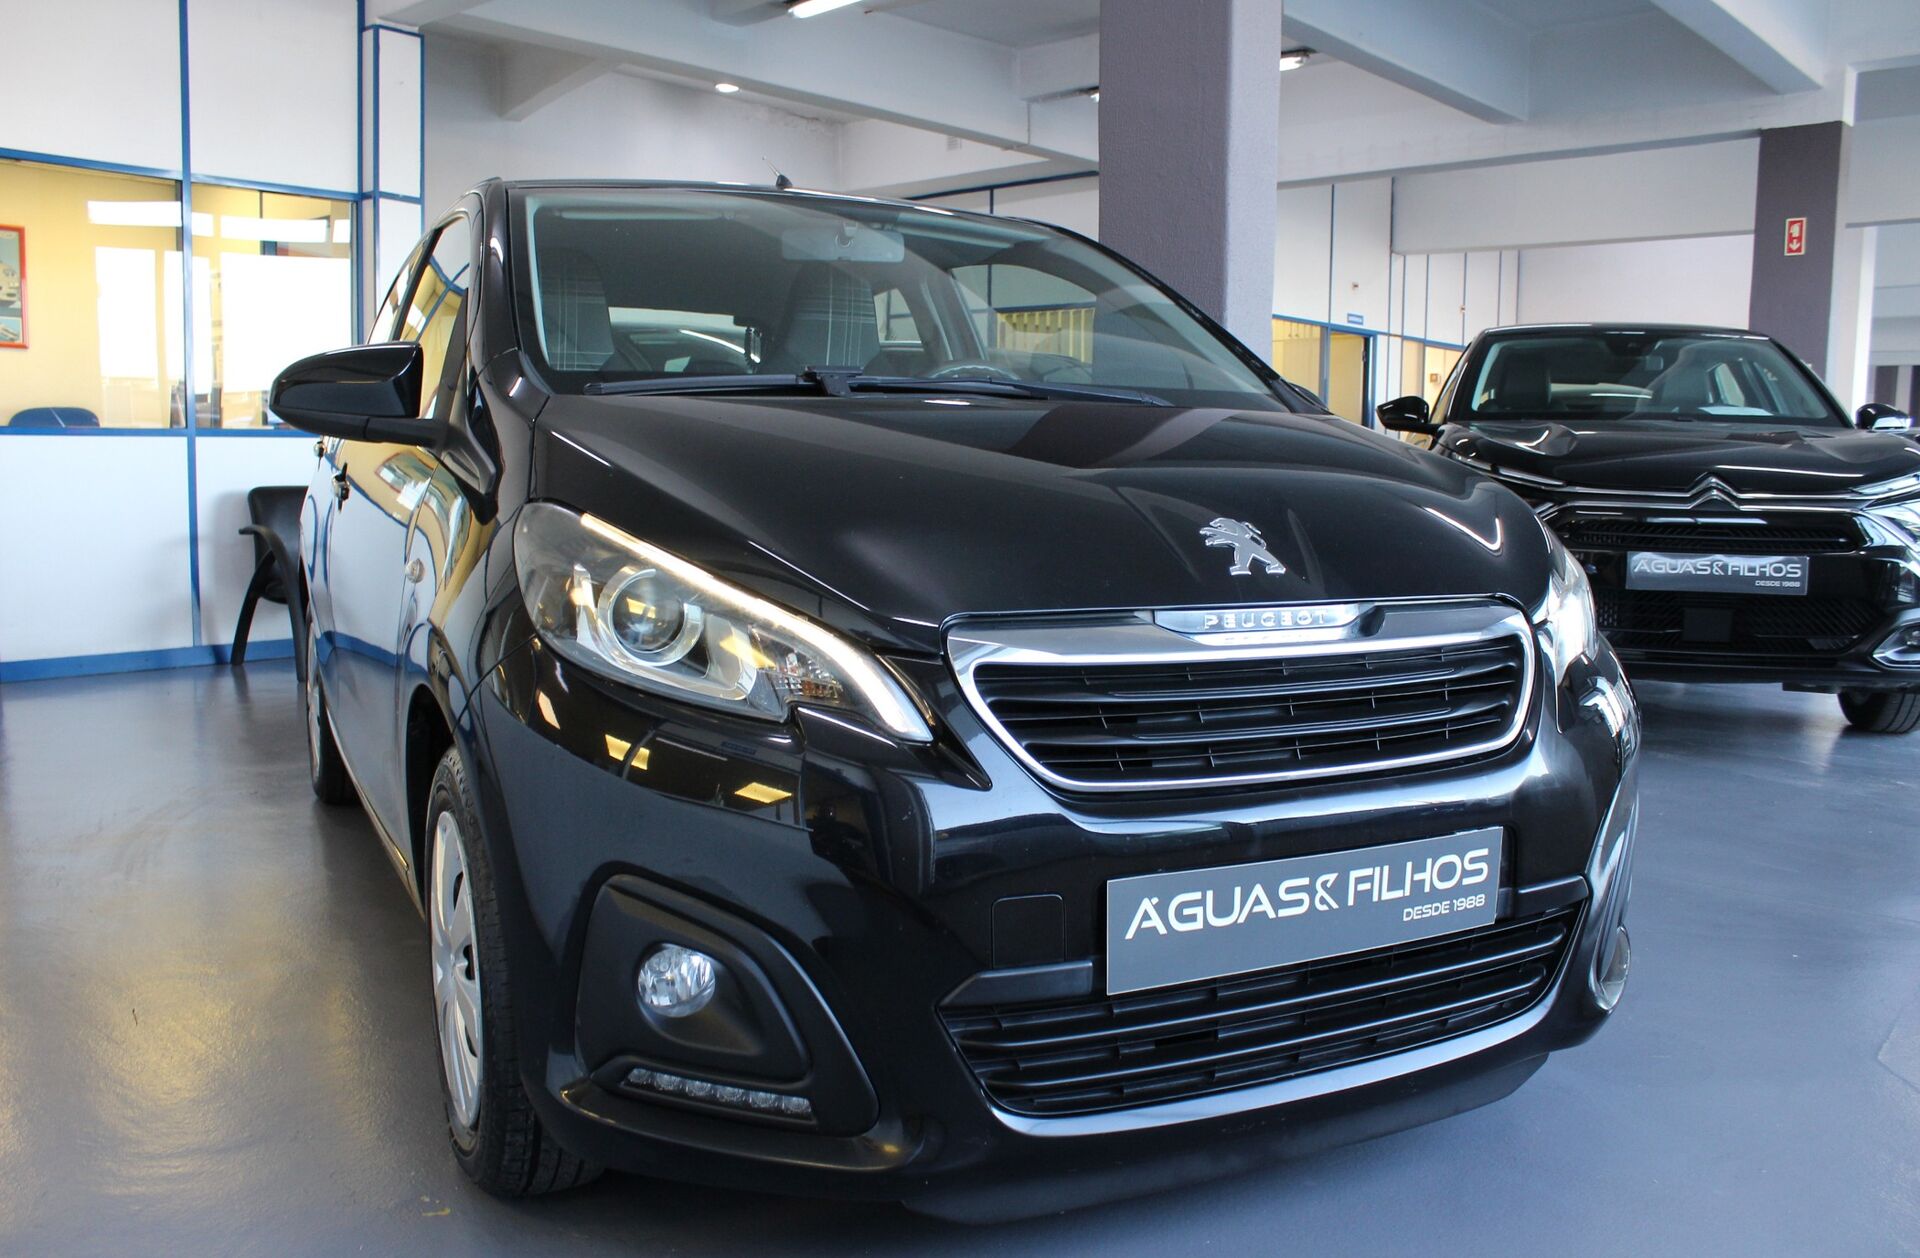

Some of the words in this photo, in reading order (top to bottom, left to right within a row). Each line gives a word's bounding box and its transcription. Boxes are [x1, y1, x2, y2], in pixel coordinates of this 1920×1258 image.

[1727, 562, 1802, 578] FILHOS
[1203, 609, 1328, 629] PEUGEOT
[1347, 847, 1489, 907] FILHOS
[1402, 902, 1451, 922] DESDE
[1452, 893, 1486, 914] 1988
